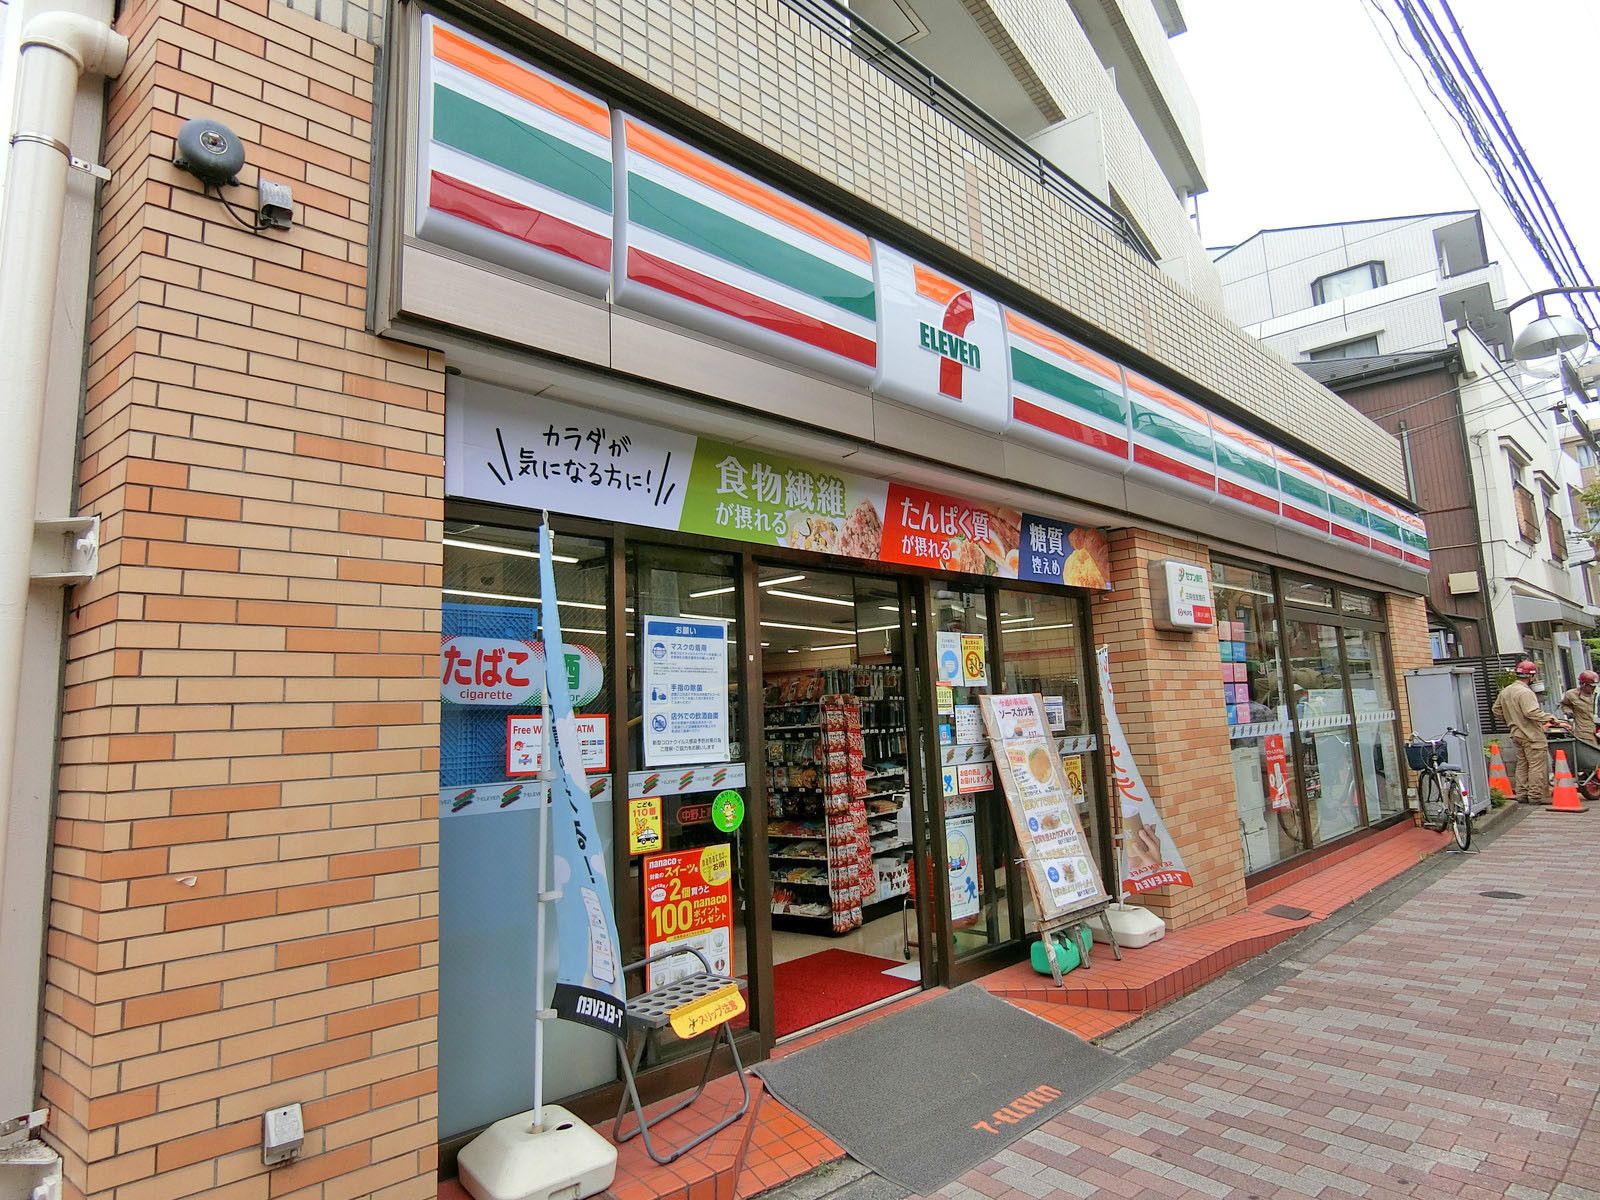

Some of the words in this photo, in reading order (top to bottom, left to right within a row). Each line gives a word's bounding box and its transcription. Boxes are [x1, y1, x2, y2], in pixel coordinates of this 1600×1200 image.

[543, 425, 631, 457] カラダが
[715, 455, 845, 517] 食物繊維
[716, 501, 787, 535] が摂れる
[900, 497, 991, 544] たんぱく質
[902, 535, 950, 560] が摂れる
[1029, 522, 1065, 557] 糖質
[1031, 555, 1061, 576] 控えめ
[675, 626, 697, 635] お願い
[442, 645, 530, 687] たばこ
[460, 689, 513, 700] cigarette
[513, 725, 531, 735] Free
[577, 724, 594, 733] ATM
[693, 895, 728, 909] nanaco
[693, 906, 720, 918] ポイント
[651, 900, 693, 937] 100
[694, 913, 727, 927] プレゼント
